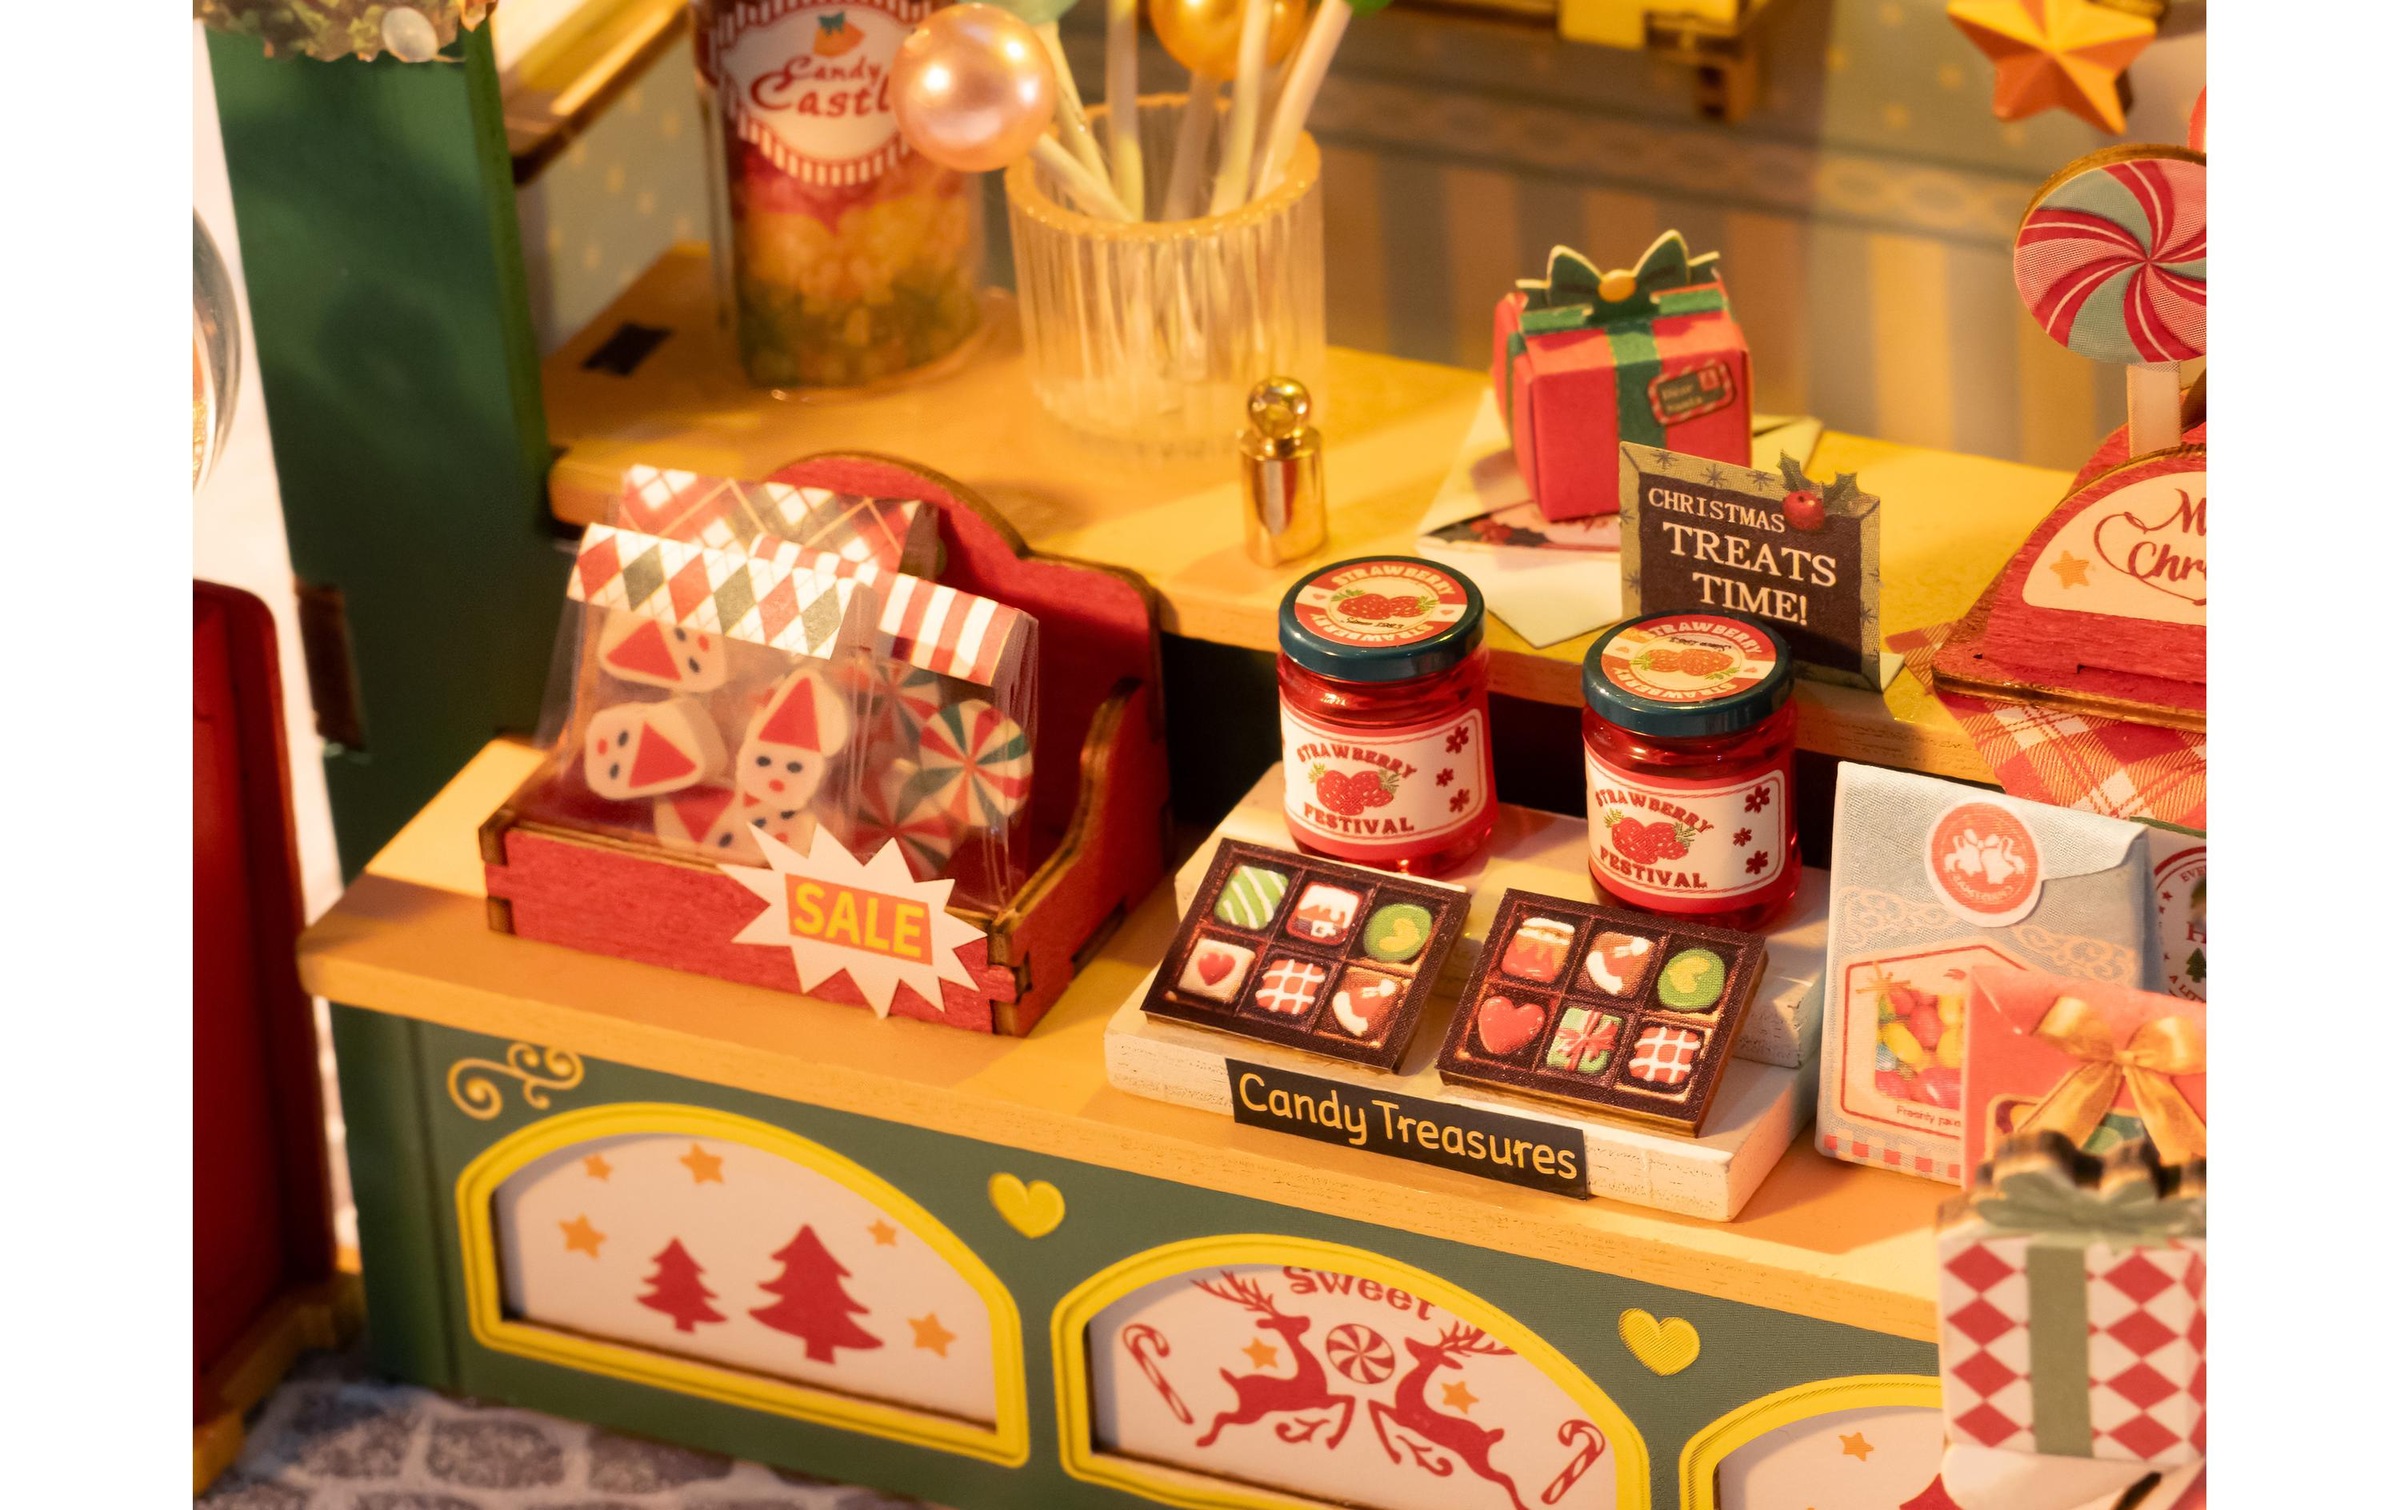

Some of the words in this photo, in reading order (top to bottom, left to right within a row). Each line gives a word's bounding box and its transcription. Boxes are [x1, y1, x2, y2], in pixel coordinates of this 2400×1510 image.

[750, 70, 891, 117] Castl
[781, 55, 882, 88] Candy
[1648, 487, 1786, 533] CHRISTMAS
[1662, 521, 1836, 587] TREATS
[1331, 565, 1456, 595] STRAWBERRY
[1692, 572, 1808, 626] TIME!
[1643, 621, 1763, 654] STRAWBERRY
[1296, 743, 1417, 779] STRAWBERRY
[1304, 801, 1415, 835] FESTIVAL
[1595, 788, 1715, 834] STRAWBERRY
[1600, 846, 1708, 889] FESTIVAL
[794, 882, 924, 958] SALE
[1239, 1073, 1366, 1145] Candy
[1372, 1100, 1577, 1180] Treasures
[1282, 1265, 1436, 1321] Sweet
